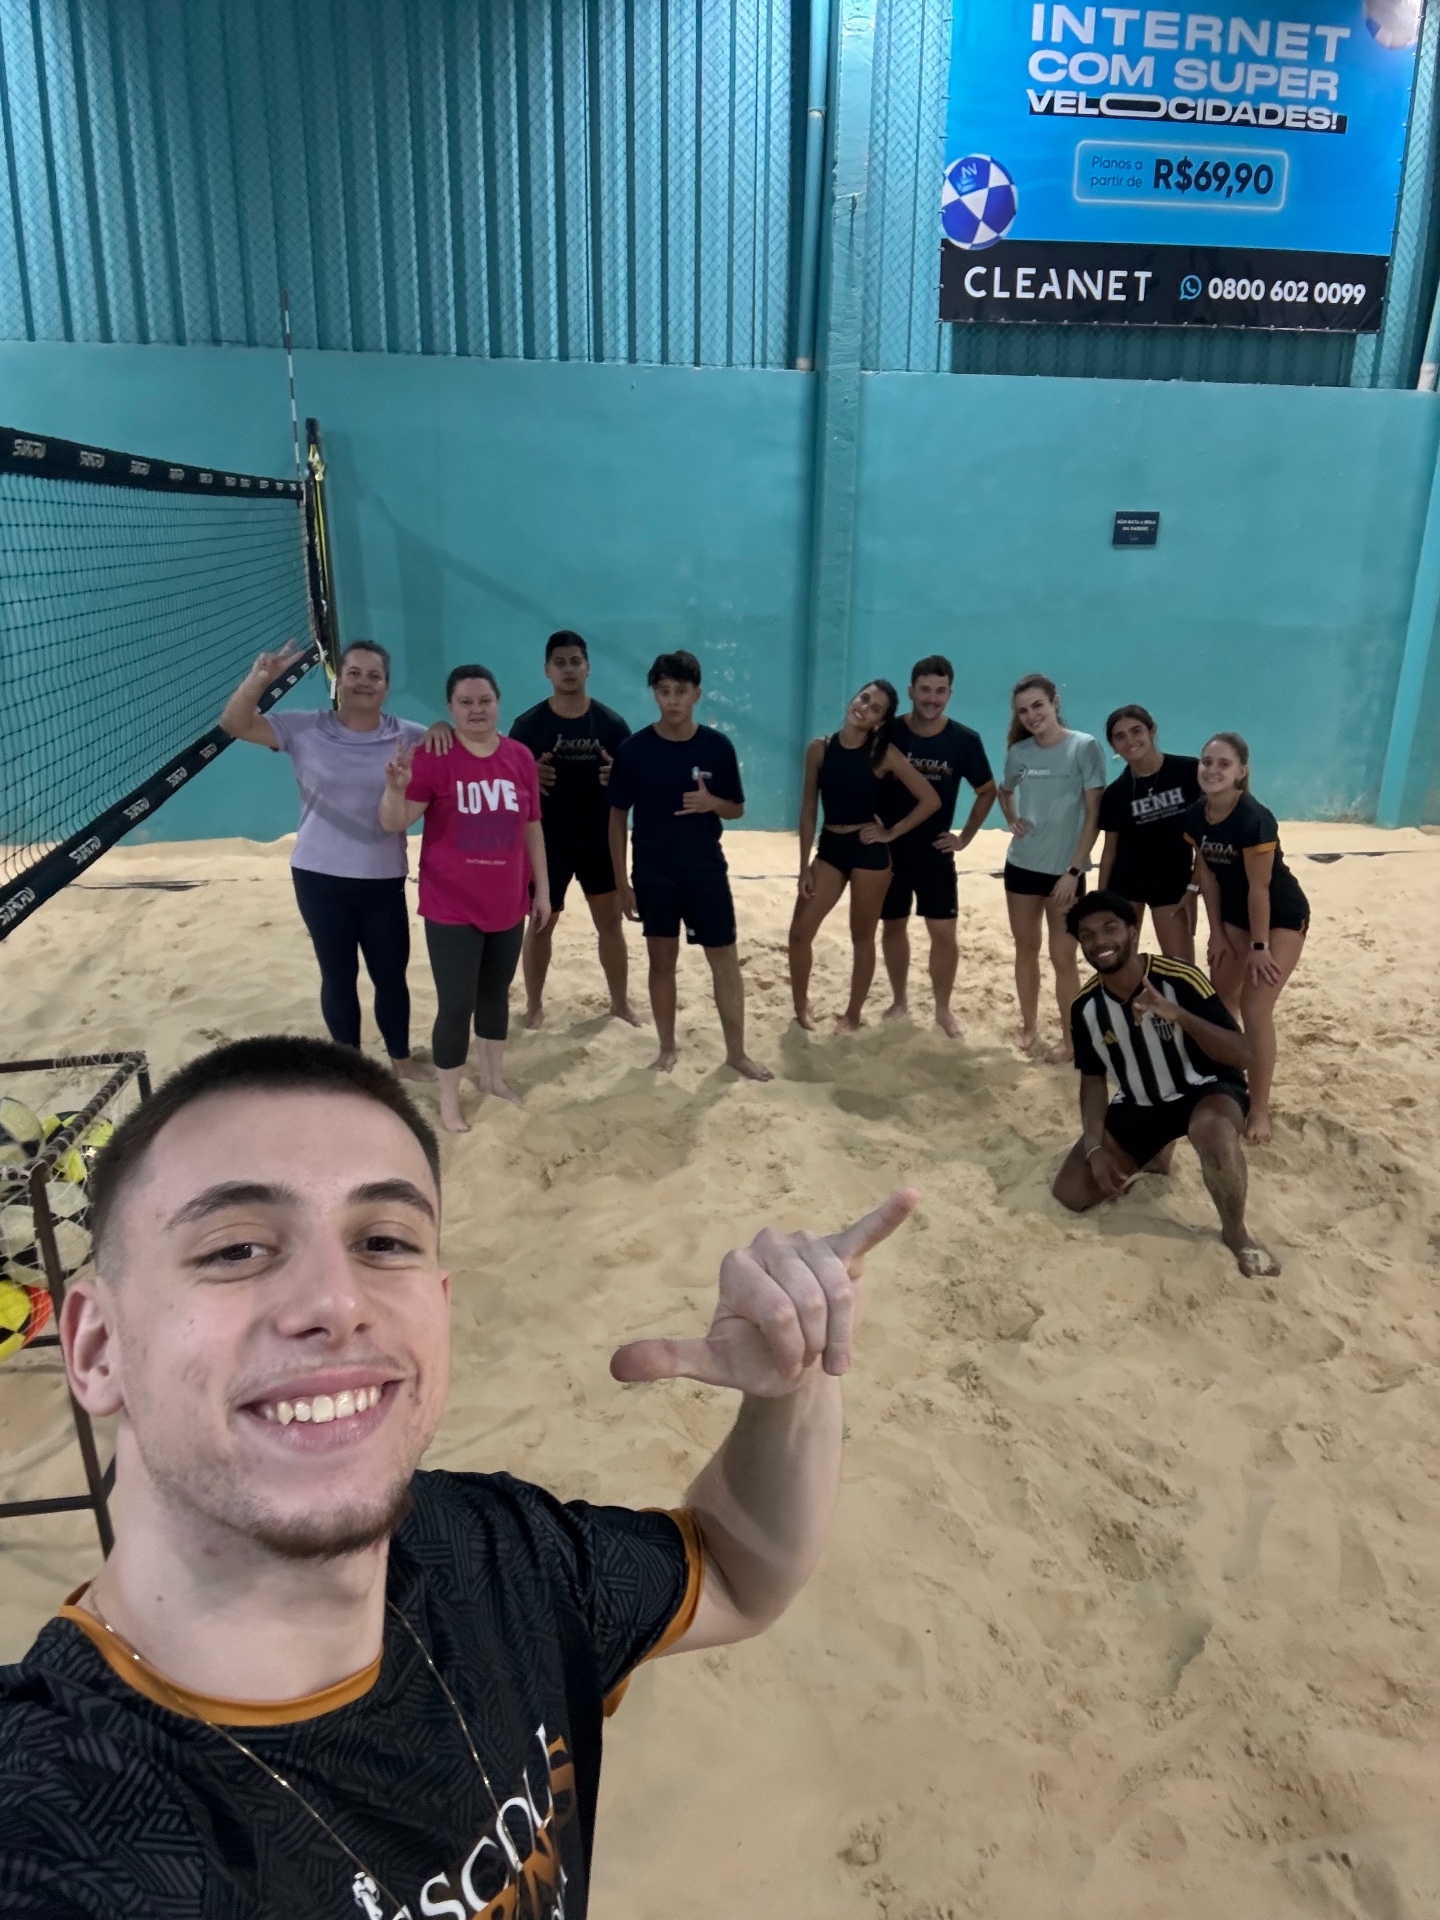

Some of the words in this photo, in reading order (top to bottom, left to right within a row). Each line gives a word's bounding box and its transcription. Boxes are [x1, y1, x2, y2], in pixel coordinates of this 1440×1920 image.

[1031, 2, 1351, 63] INTERNET
[1028, 49, 1156, 88] COM
[1173, 57, 1339, 101] SUPER
[1026, 88, 1339, 131] VELOCIDADES!
[1090, 173, 1124, 189] partir
[1125, 175, 1143, 189] de
[1091, 155, 1133, 171] Planos
[1135, 160, 1143, 170] a
[1153, 155, 1275, 199] R$69,90
[963, 266, 1153, 302] CLEANNET
[1207, 277, 1266, 301] 0800
[1269, 279, 1309, 303] 602
[1313, 281, 1366, 305] 0099
[456, 778, 520, 815] LOVE
[1130, 786, 1186, 817] IENH
